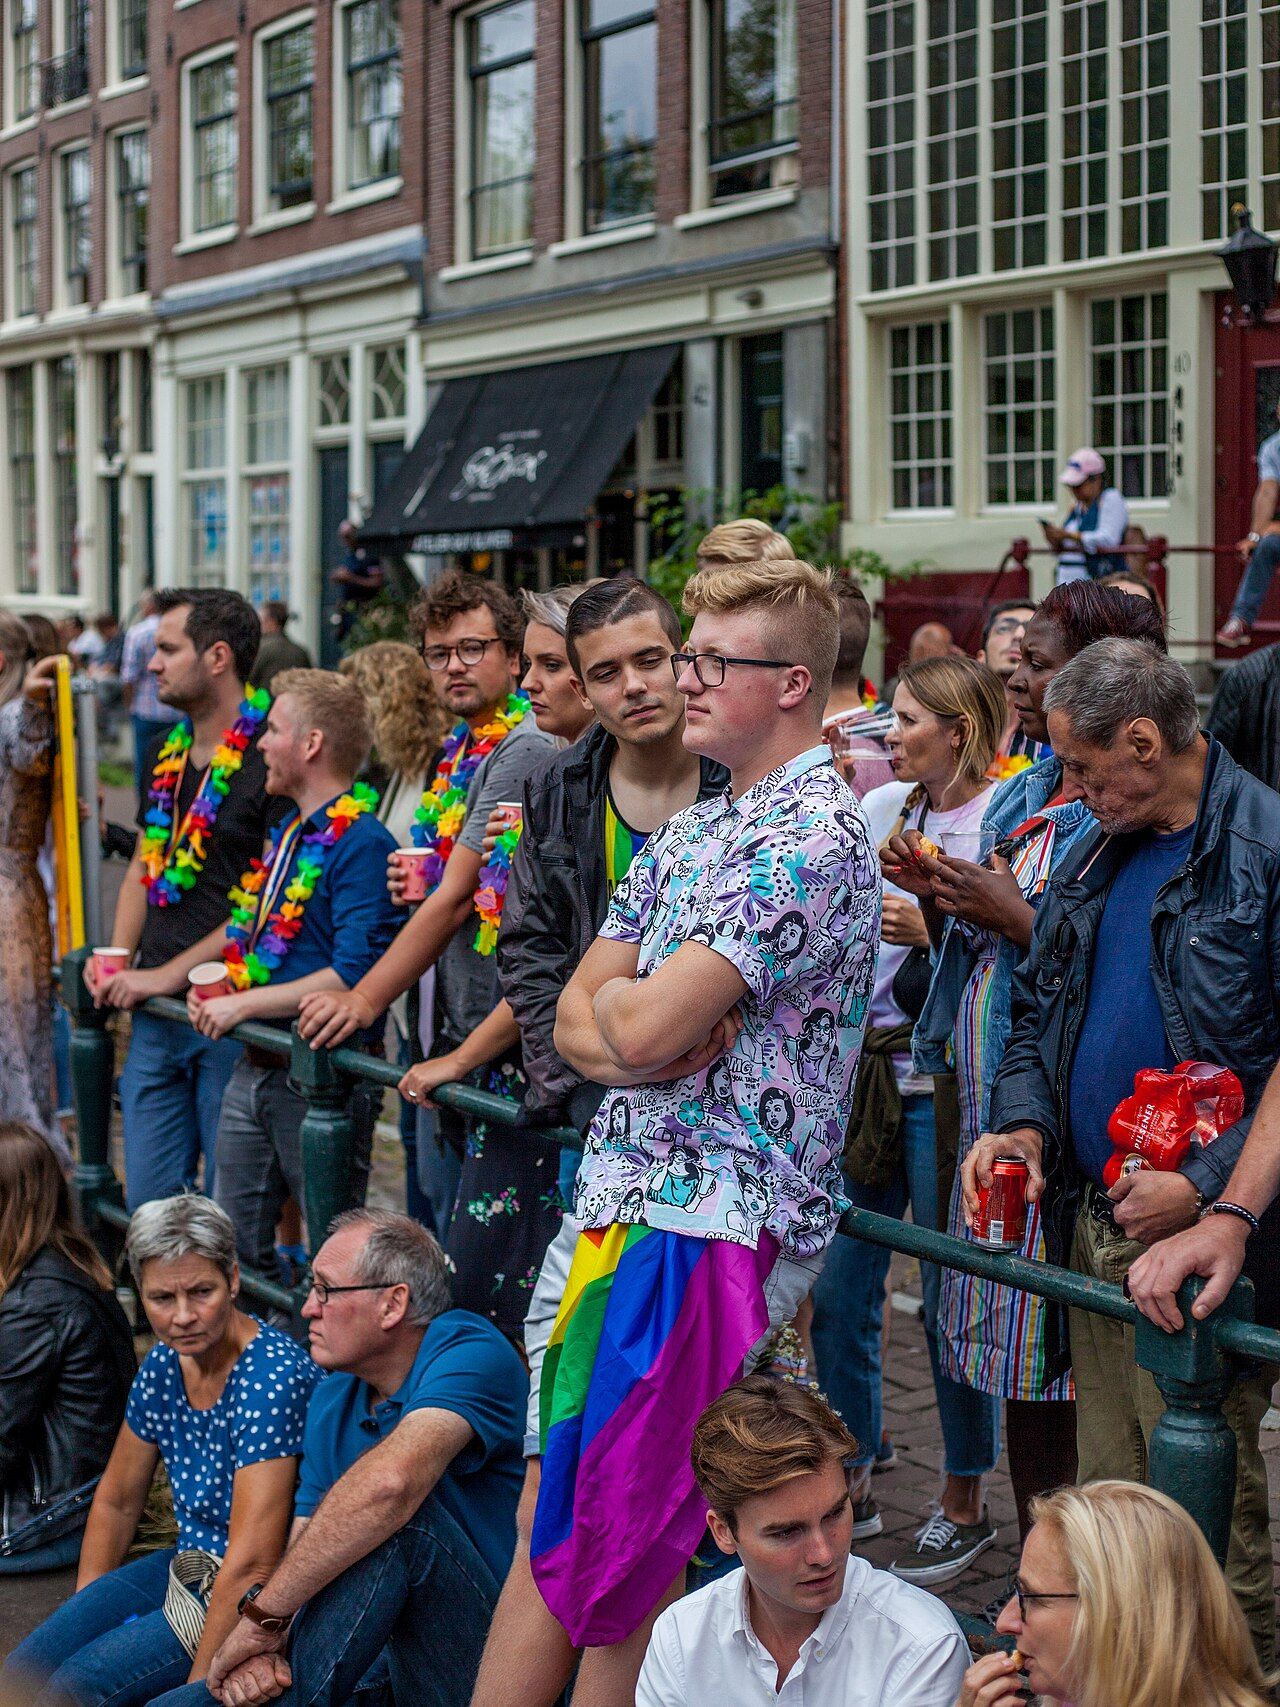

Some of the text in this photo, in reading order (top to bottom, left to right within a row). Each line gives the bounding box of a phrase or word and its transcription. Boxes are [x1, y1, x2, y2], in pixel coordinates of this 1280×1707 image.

[629, 1092, 660, 1110] OMG!
[793, 1090, 826, 1108] OMG!
[1134, 1103, 1156, 1150] PILSENER
